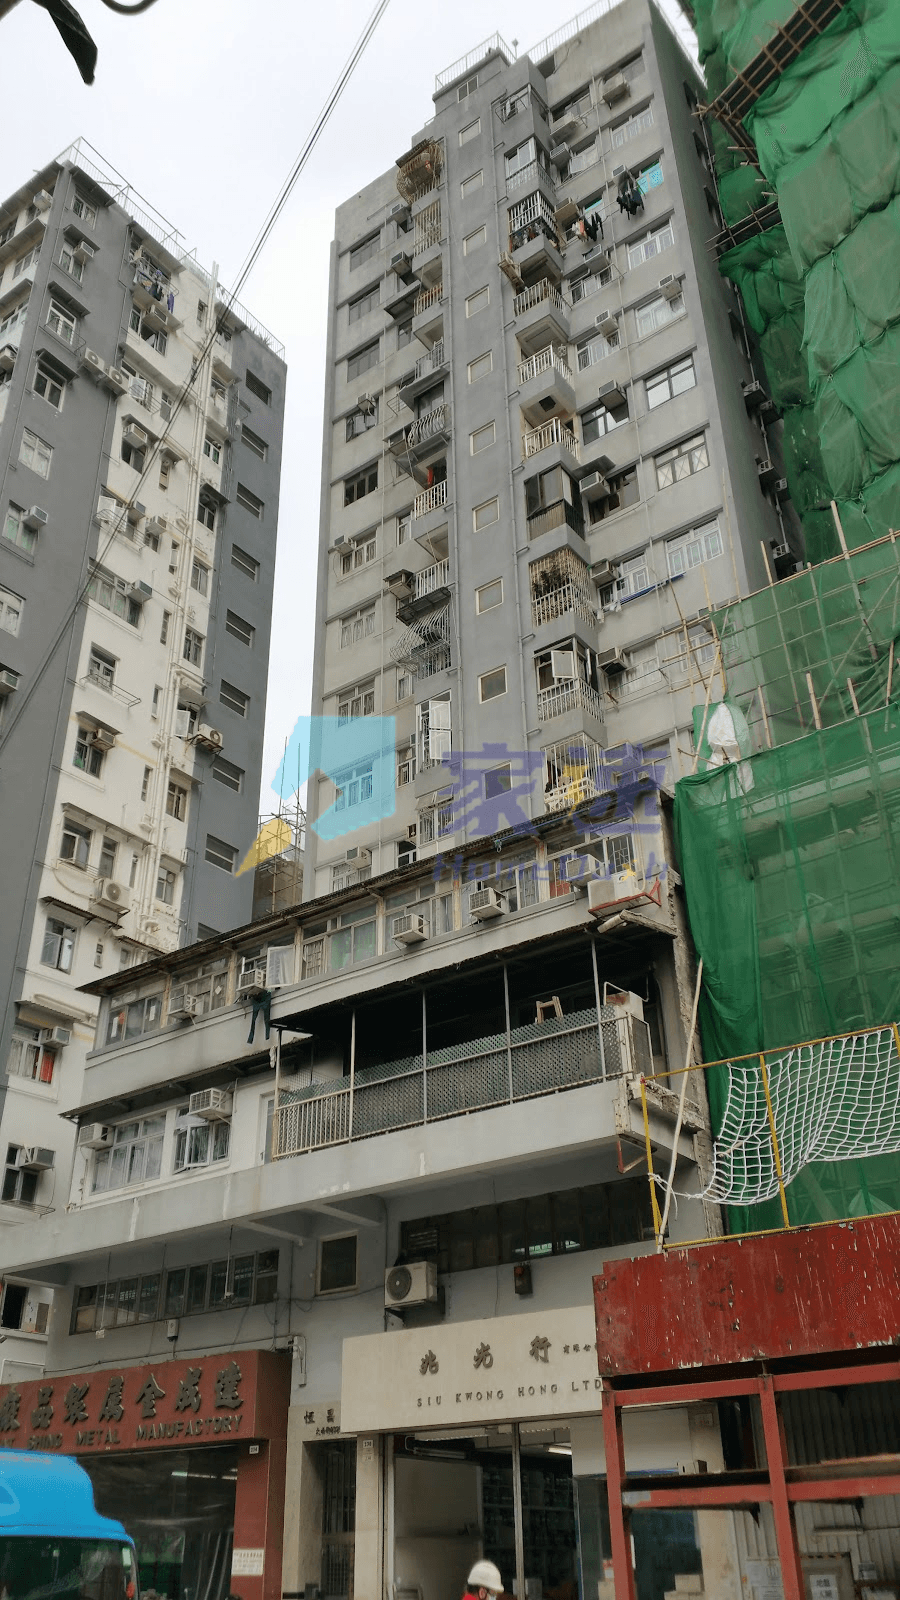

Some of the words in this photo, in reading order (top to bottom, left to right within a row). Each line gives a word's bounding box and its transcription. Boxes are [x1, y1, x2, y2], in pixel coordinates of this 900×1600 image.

[419, 1335, 552, 1375] 兆光行
[417, 1396, 442, 1408] SIU
[455, 1390, 504, 1404] KWONG
[517, 1384, 558, 1397] HONG
[76, 1427, 120, 1446] METAL
[136, 1415, 242, 1441] MANUFACTORY
